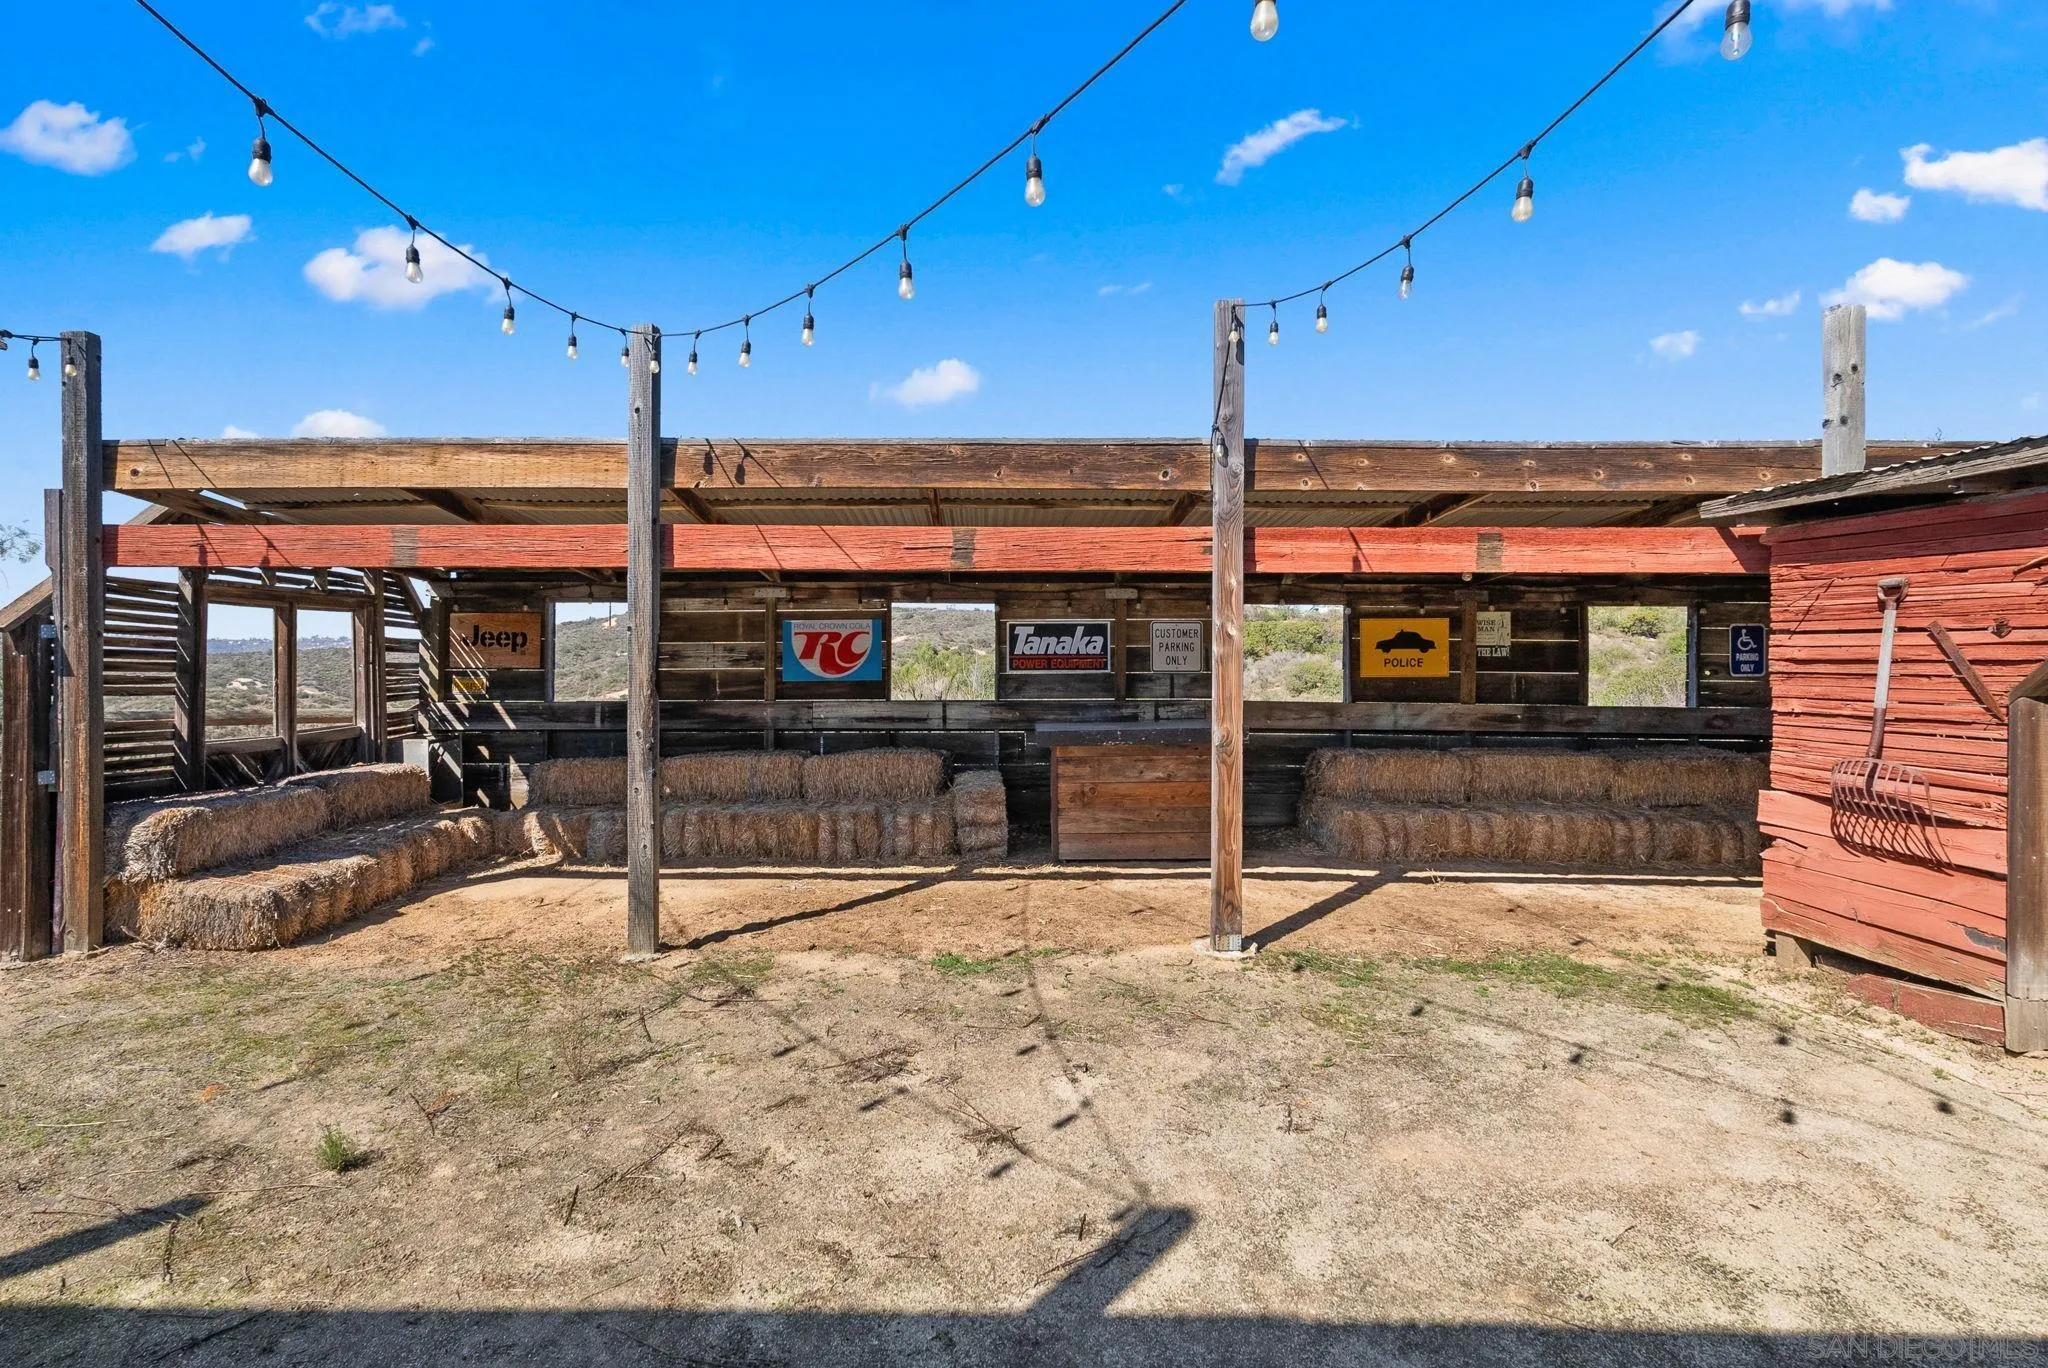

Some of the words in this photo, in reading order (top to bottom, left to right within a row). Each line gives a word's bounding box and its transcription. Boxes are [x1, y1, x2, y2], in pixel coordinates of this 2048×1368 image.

[1155, 629, 1199, 638] CUSTOMER
[462, 625, 528, 652] Jeep
[1014, 626, 1104, 655] Tanaka
[1159, 642, 1195, 652] PARKING
[1477, 647, 1491, 656] THE
[794, 632, 870, 675] RC
[1736, 653, 1759, 661] PARKING
[1013, 660, 1047, 668] POWER
[1051, 660, 1104, 668] EQUIPMENT
[1166, 656, 1187, 665] ONLY
[1384, 658, 1424, 668] POLICE
[1740, 664, 1755, 672] ONLY
